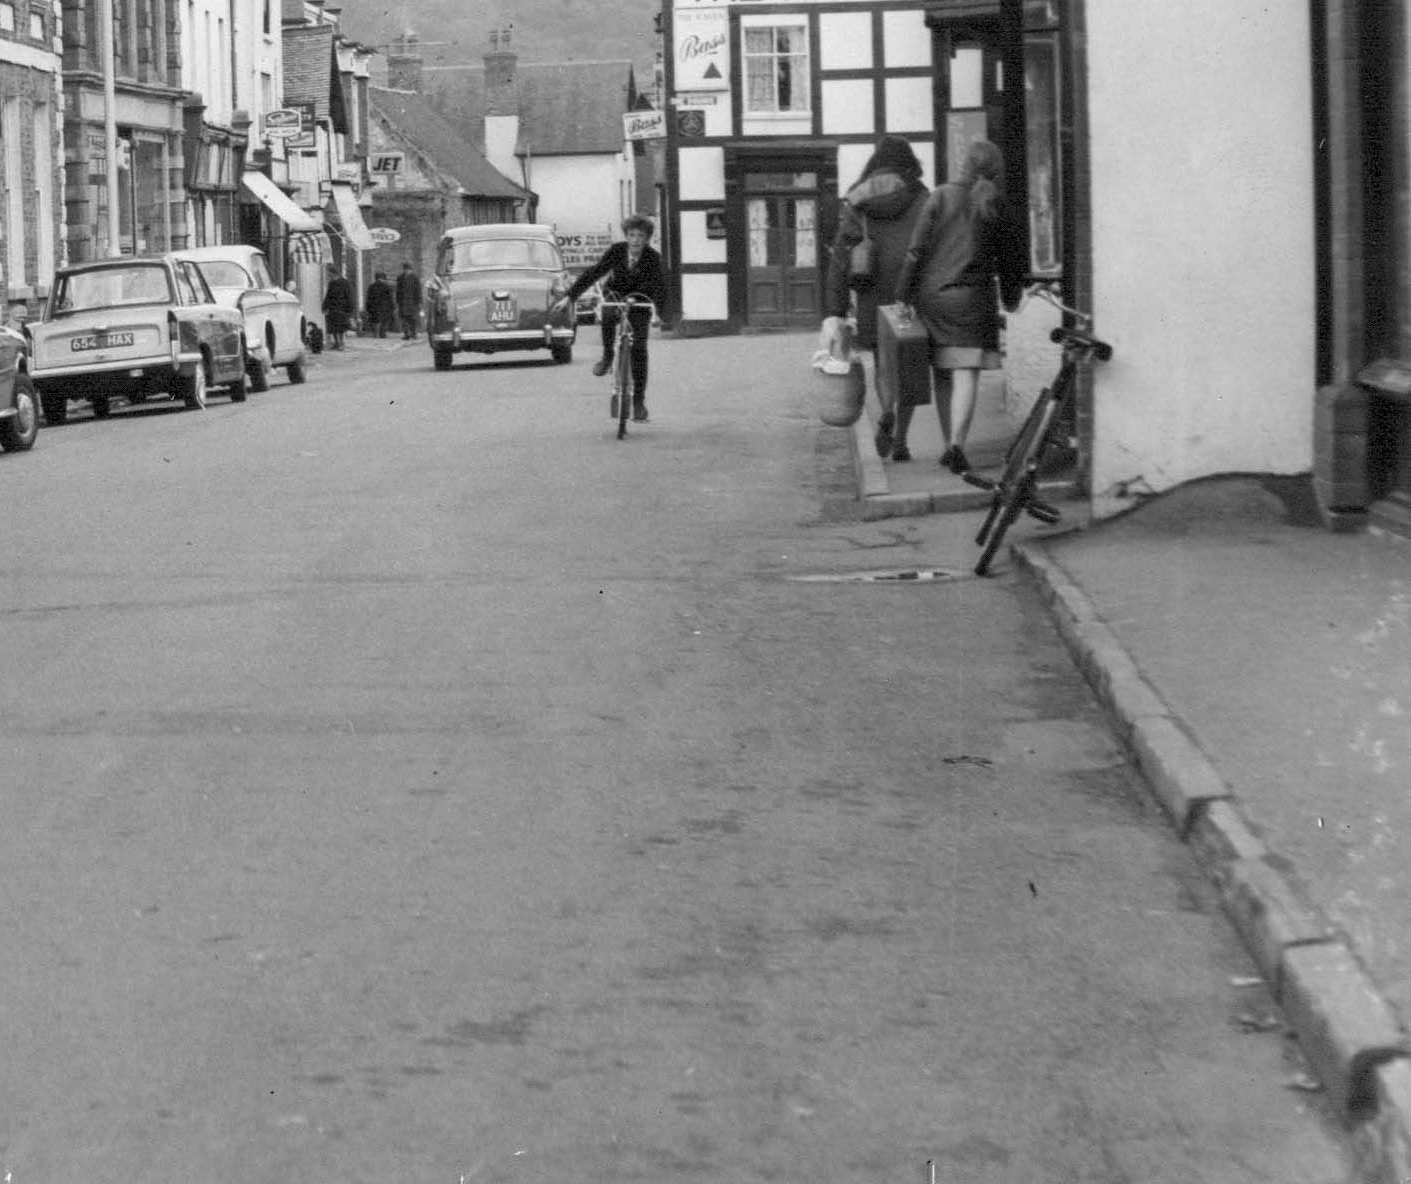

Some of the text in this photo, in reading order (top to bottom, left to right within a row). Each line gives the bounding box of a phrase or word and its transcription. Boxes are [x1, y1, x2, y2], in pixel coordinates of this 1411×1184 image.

[678, 34, 726, 62] Bass
[628, 115, 663, 134] Bass
[373, 157, 402, 171] JET
[107, 333, 132, 346] HAX
